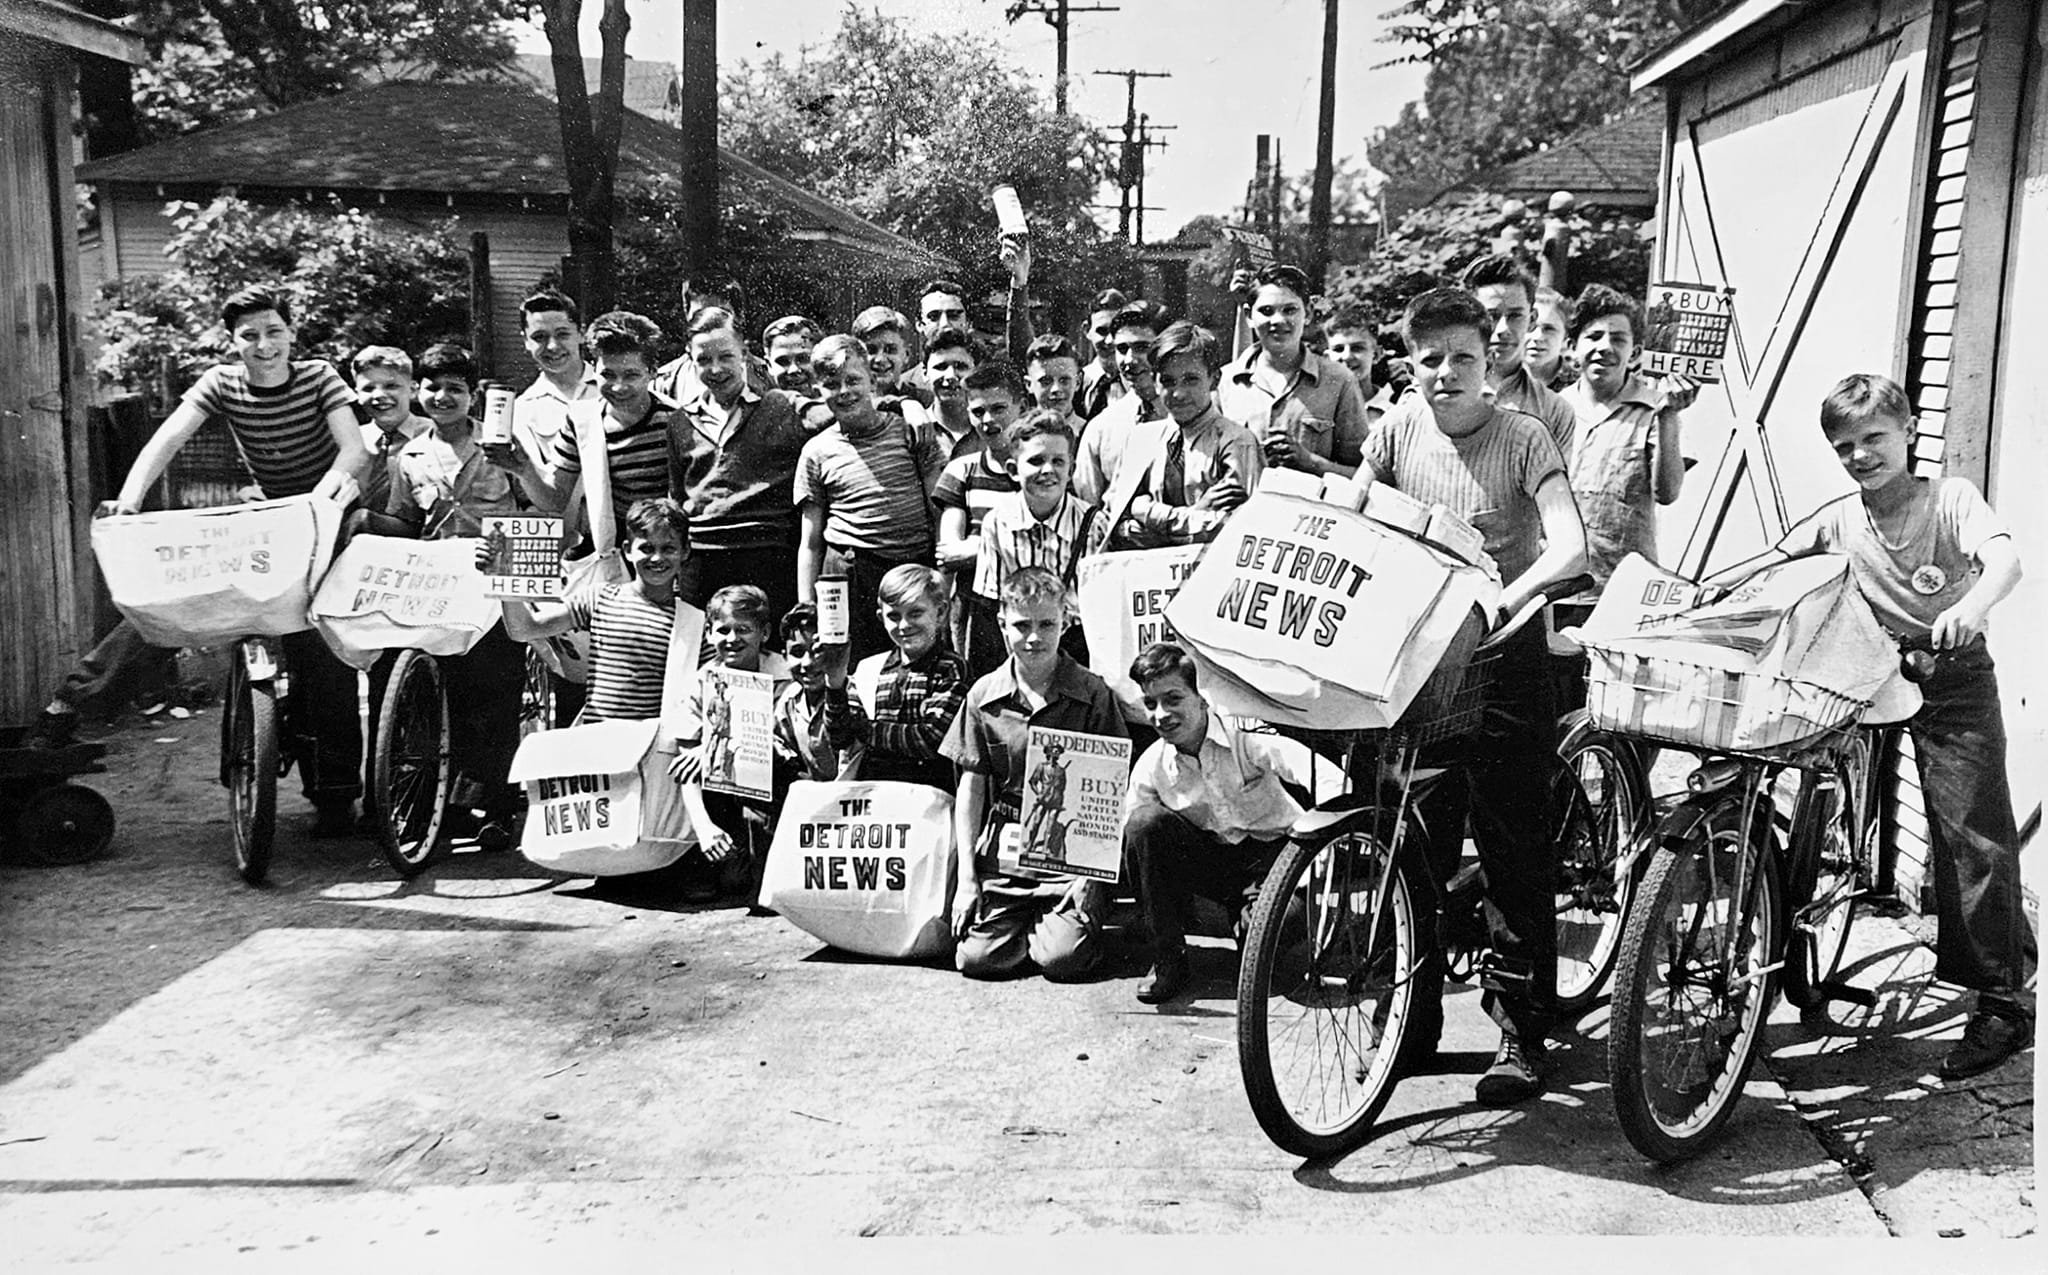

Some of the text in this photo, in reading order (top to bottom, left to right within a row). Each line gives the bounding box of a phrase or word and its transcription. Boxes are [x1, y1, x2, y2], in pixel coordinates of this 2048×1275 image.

[1680, 292, 1729, 312] BUY
[1680, 313, 1727, 327] DEFENSE
[1676, 326, 1726, 341] SAVINGS
[1674, 340, 1722, 355] STAMPS
[1651, 354, 1714, 376] HERE
[512, 520, 556, 536] BUY
[1293, 514, 1337, 540] THE
[512, 551, 559, 562] SAVINGS
[512, 563, 559, 575] STAMPS
[1236, 535, 1373, 598] DETROIT
[491, 577, 553, 595] HERE
[1216, 577, 1346, 647] NEWS
[741, 708, 770, 727] BUY
[1032, 731, 1129, 758] FOR DEFENSE
[1081, 777, 1122, 797] BUY
[839, 799, 872, 816] THE
[1081, 795, 1120, 807] UNITED
[1081, 804, 1118, 815] STATES
[544, 797, 610, 836] NEWS
[1077, 812, 1120, 824] SAVINGS
[800, 823, 911, 848] DETROIT
[1079, 821, 1116, 832] BONDS
[804, 856, 906, 890] NEWS
